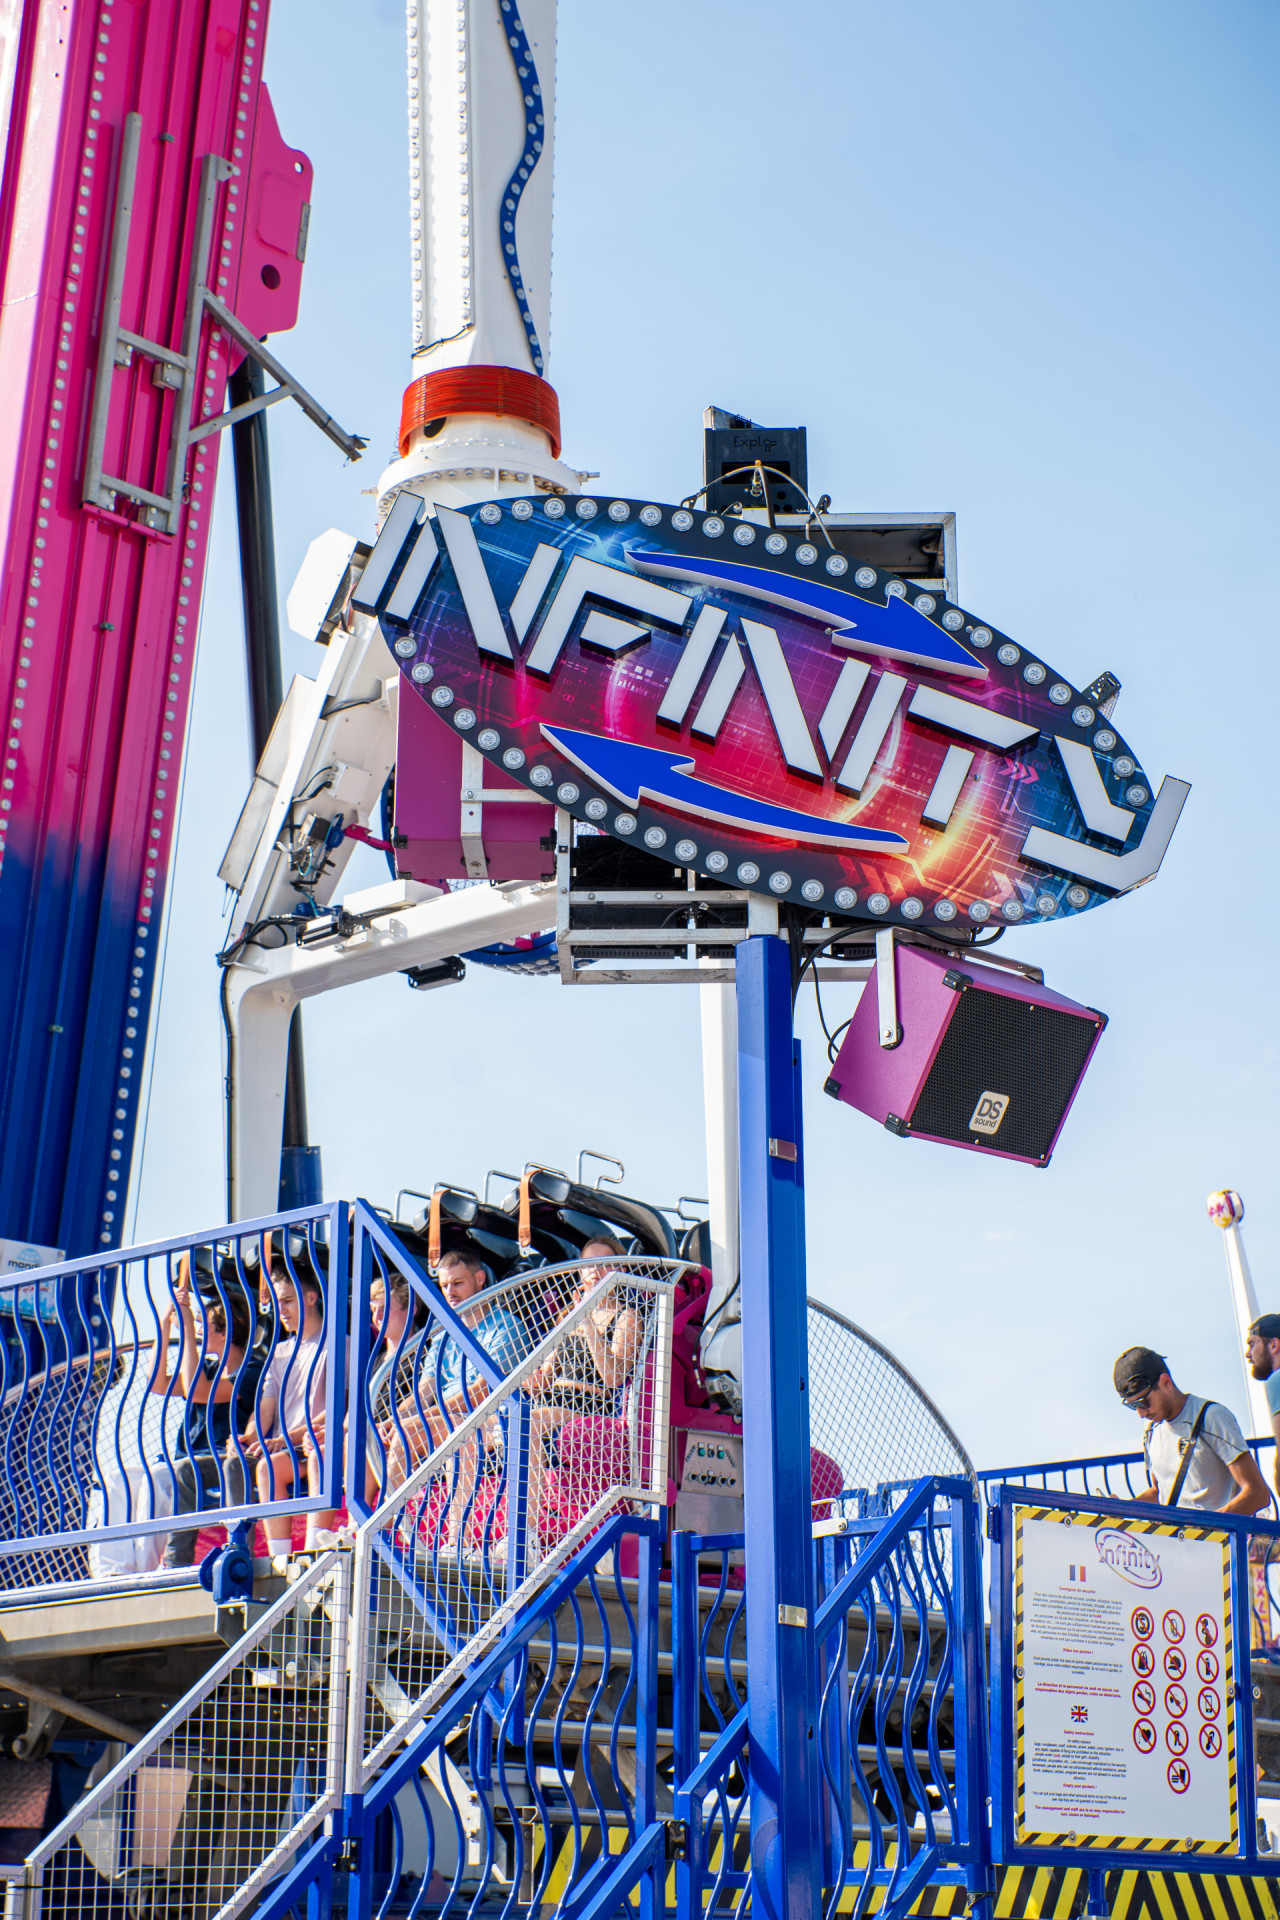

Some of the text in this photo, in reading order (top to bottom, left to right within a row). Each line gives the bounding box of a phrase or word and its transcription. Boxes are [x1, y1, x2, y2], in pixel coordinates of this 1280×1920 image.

[352, 490, 1192, 898] INFINITY
[973, 1117, 997, 1128] sound
[977, 1098, 1003, 1120] DS
[1098, 1542, 1161, 1575] Infinity
